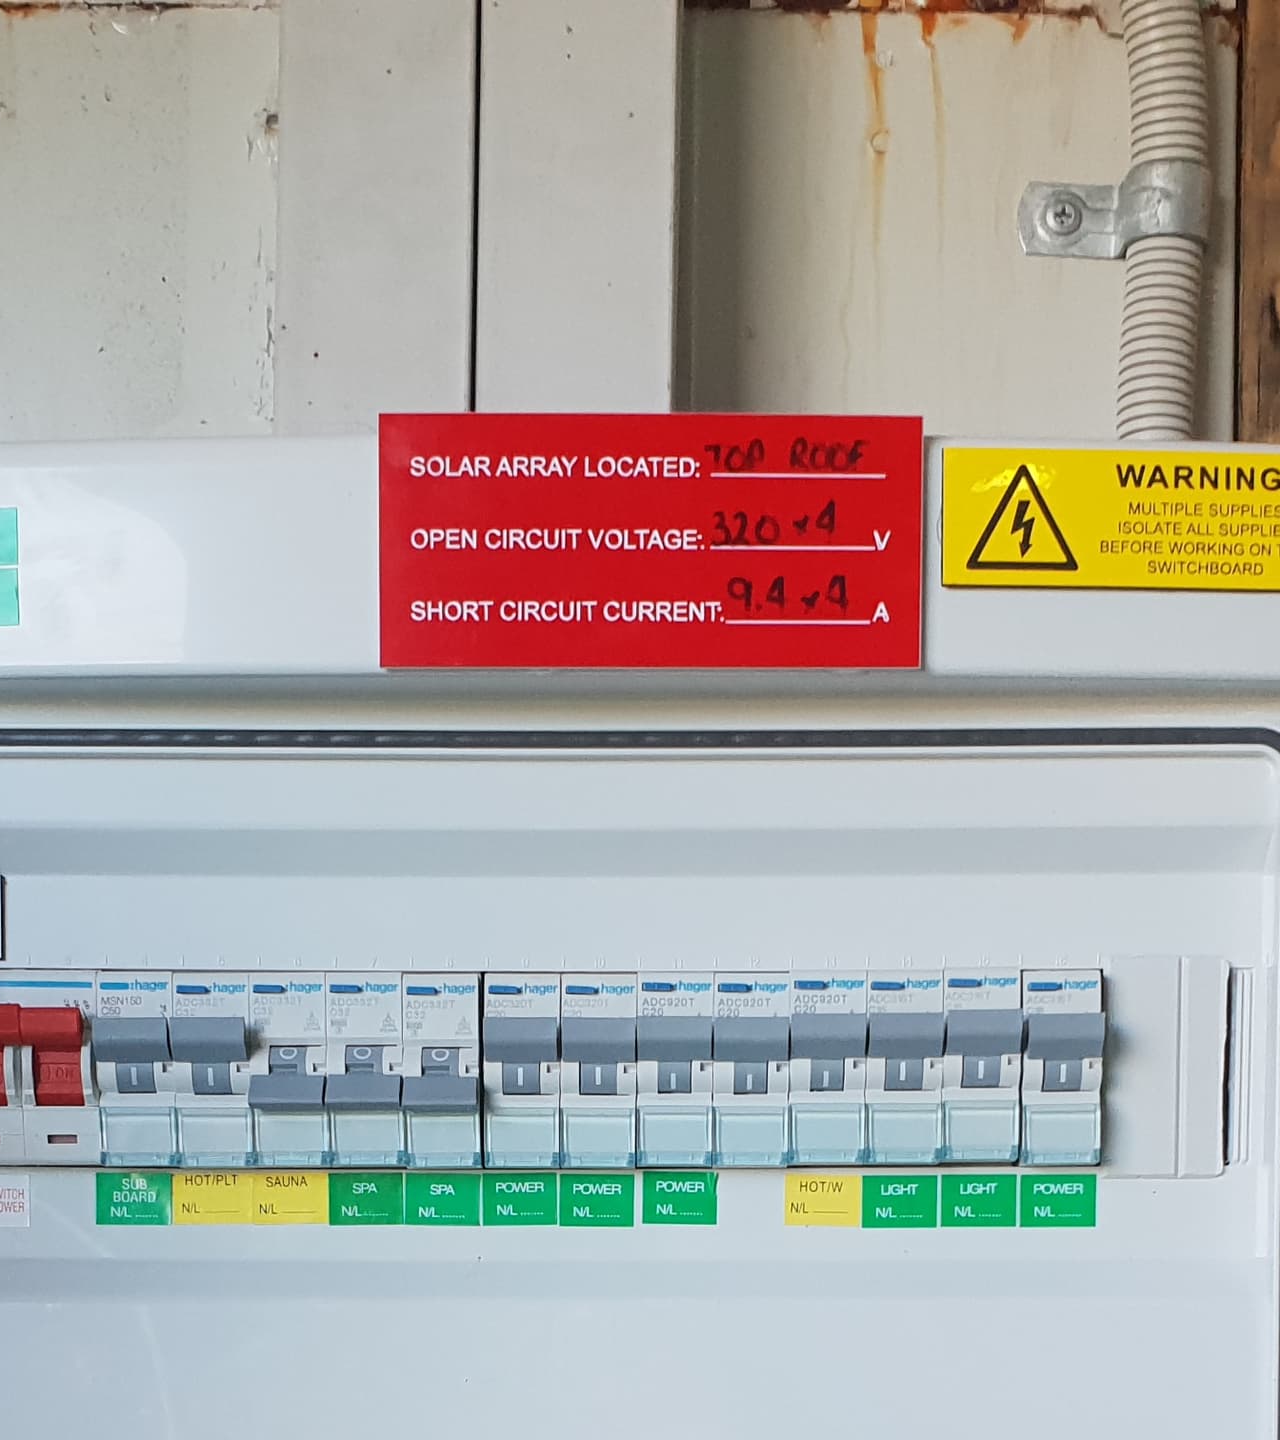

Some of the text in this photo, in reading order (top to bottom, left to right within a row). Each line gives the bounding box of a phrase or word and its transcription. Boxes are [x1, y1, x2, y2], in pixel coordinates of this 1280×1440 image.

[410, 456, 491, 478] SOLAR
[496, 456, 580, 478] ARRAY
[585, 456, 701, 479] LOCATED:
[704, 438, 765, 472] TOP
[1128, 502, 1204, 517] MULTIPLE
[411, 529, 478, 550] OPEN
[484, 529, 582, 550] CIRCUIT
[587, 529, 705, 551] VOLTAGE:
[711, 511, 780, 546] 320
[873, 530, 891, 551] V
[1118, 521, 1182, 535] ISOLATE
[1186, 522, 1214, 536] ALL
[1100, 540, 1165, 554] BEFORE
[1168, 541, 1245, 556] WORKING
[1249, 543, 1272, 556] ON
[1147, 561, 1265, 576] SWITCHBOARD
[411, 601, 493, 623] SHORT
[503, 601, 594, 623] CIRCUIT
[598, 601, 725, 624] CURRENT:
[872, 601, 890, 623] A
[101, 996, 142, 1005] MSN150
[101, 1007, 121, 1015] C50
[642, 1008, 664, 1016] C20
[718, 1008, 740, 1017] C20
[794, 1004, 816, 1014] C20
[122, 1178, 147, 1189] SUB
[185, 1175, 238, 1186] HOT/PLT
[266, 1176, 307, 1188] SAUNA
[656, 1180, 704, 1193] POWER
[352, 1182, 377, 1194] SPA
[430, 1184, 455, 1195] SPA
[495, 1181, 544, 1193] POWER
[573, 1183, 622, 1195] POWER
[799, 1181, 843, 1193] HOT/W
[880, 1184, 919, 1195] LIGHT
[960, 1183, 998, 1195] LIGHT
[1033, 1183, 1083, 1195] POWER
[113, 1191, 157, 1203] BOARD
[110, 1206, 132, 1218] N/L
[182, 1203, 200, 1214] N/L
[259, 1204, 277, 1214] N/L
[341, 1205, 362, 1217] N/L
[418, 1206, 440, 1218] N/L
[496, 1204, 517, 1216] N/L
[573, 1206, 594, 1218] N/L
[656, 1204, 677, 1215] N/L
[790, 1202, 809, 1214] N/L
[875, 1207, 897, 1218] N/L
[954, 1206, 975, 1218] N/L
[1034, 1206, 1055, 1218] N/L
